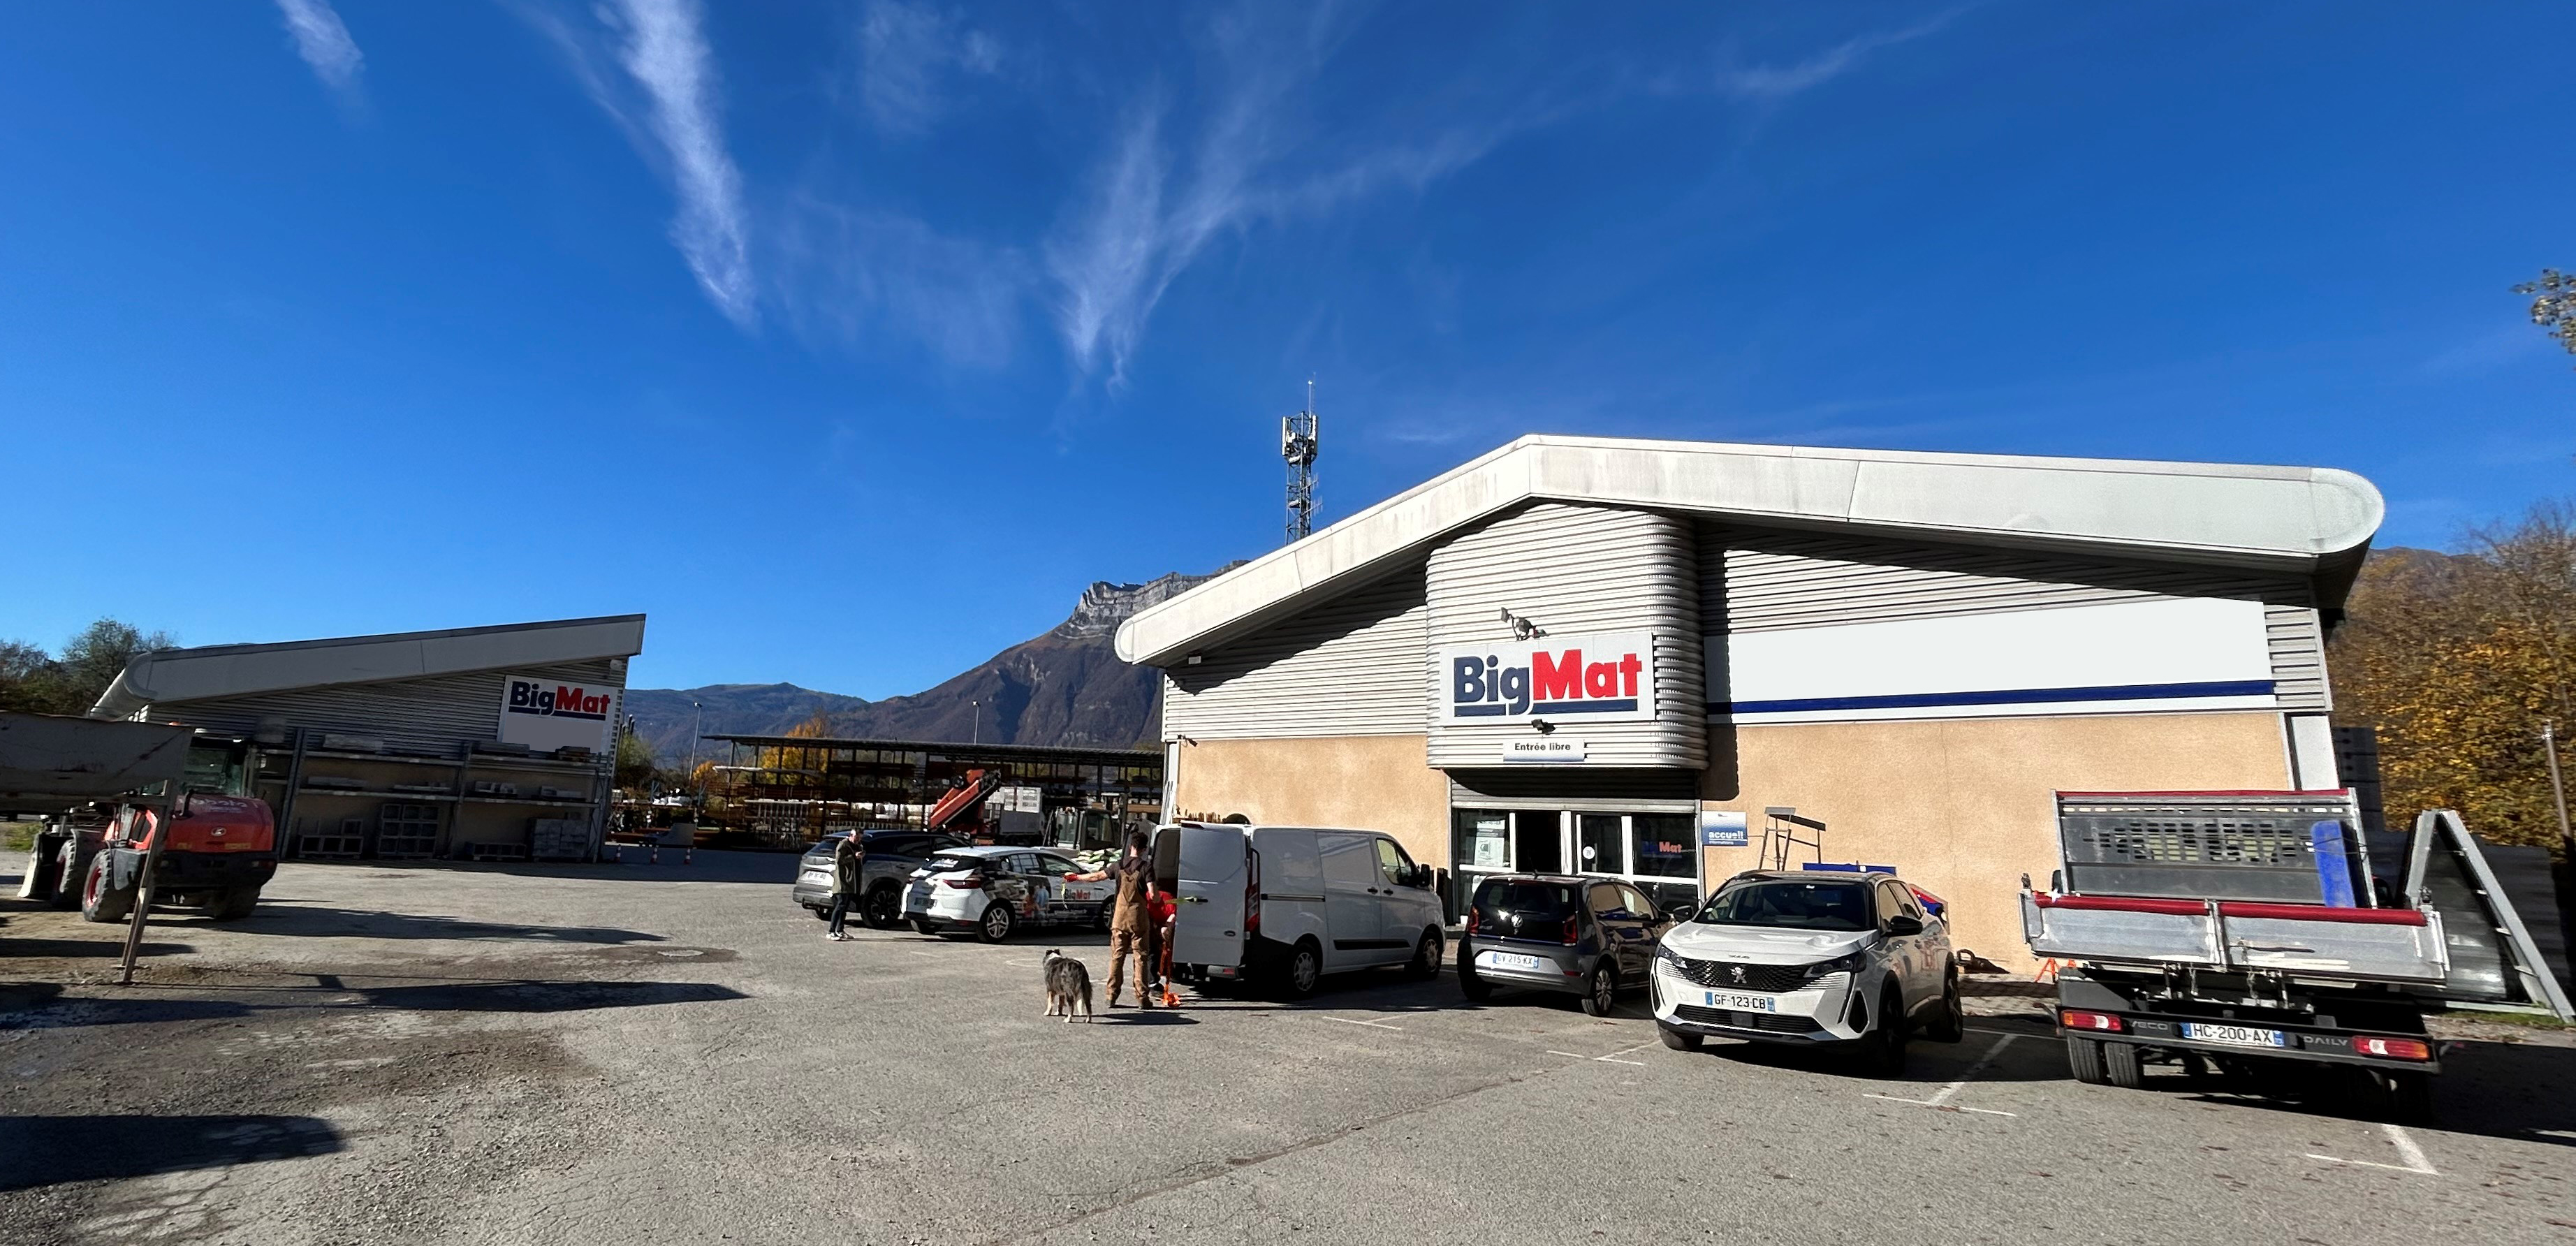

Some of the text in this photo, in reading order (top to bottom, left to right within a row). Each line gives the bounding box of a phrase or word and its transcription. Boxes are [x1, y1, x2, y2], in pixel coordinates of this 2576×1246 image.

[1454, 649, 1642, 715] BigMat
[509, 681, 610, 715] BigMat
[1514, 742, 1571, 751] Entrée libre
[1714, 994, 1766, 1009] GF-123-CB
[2131, 1020, 2169, 1030] VECO
[2193, 1024, 2273, 1043] HC-200-AX
[2302, 1036, 2348, 1046] DAILY
